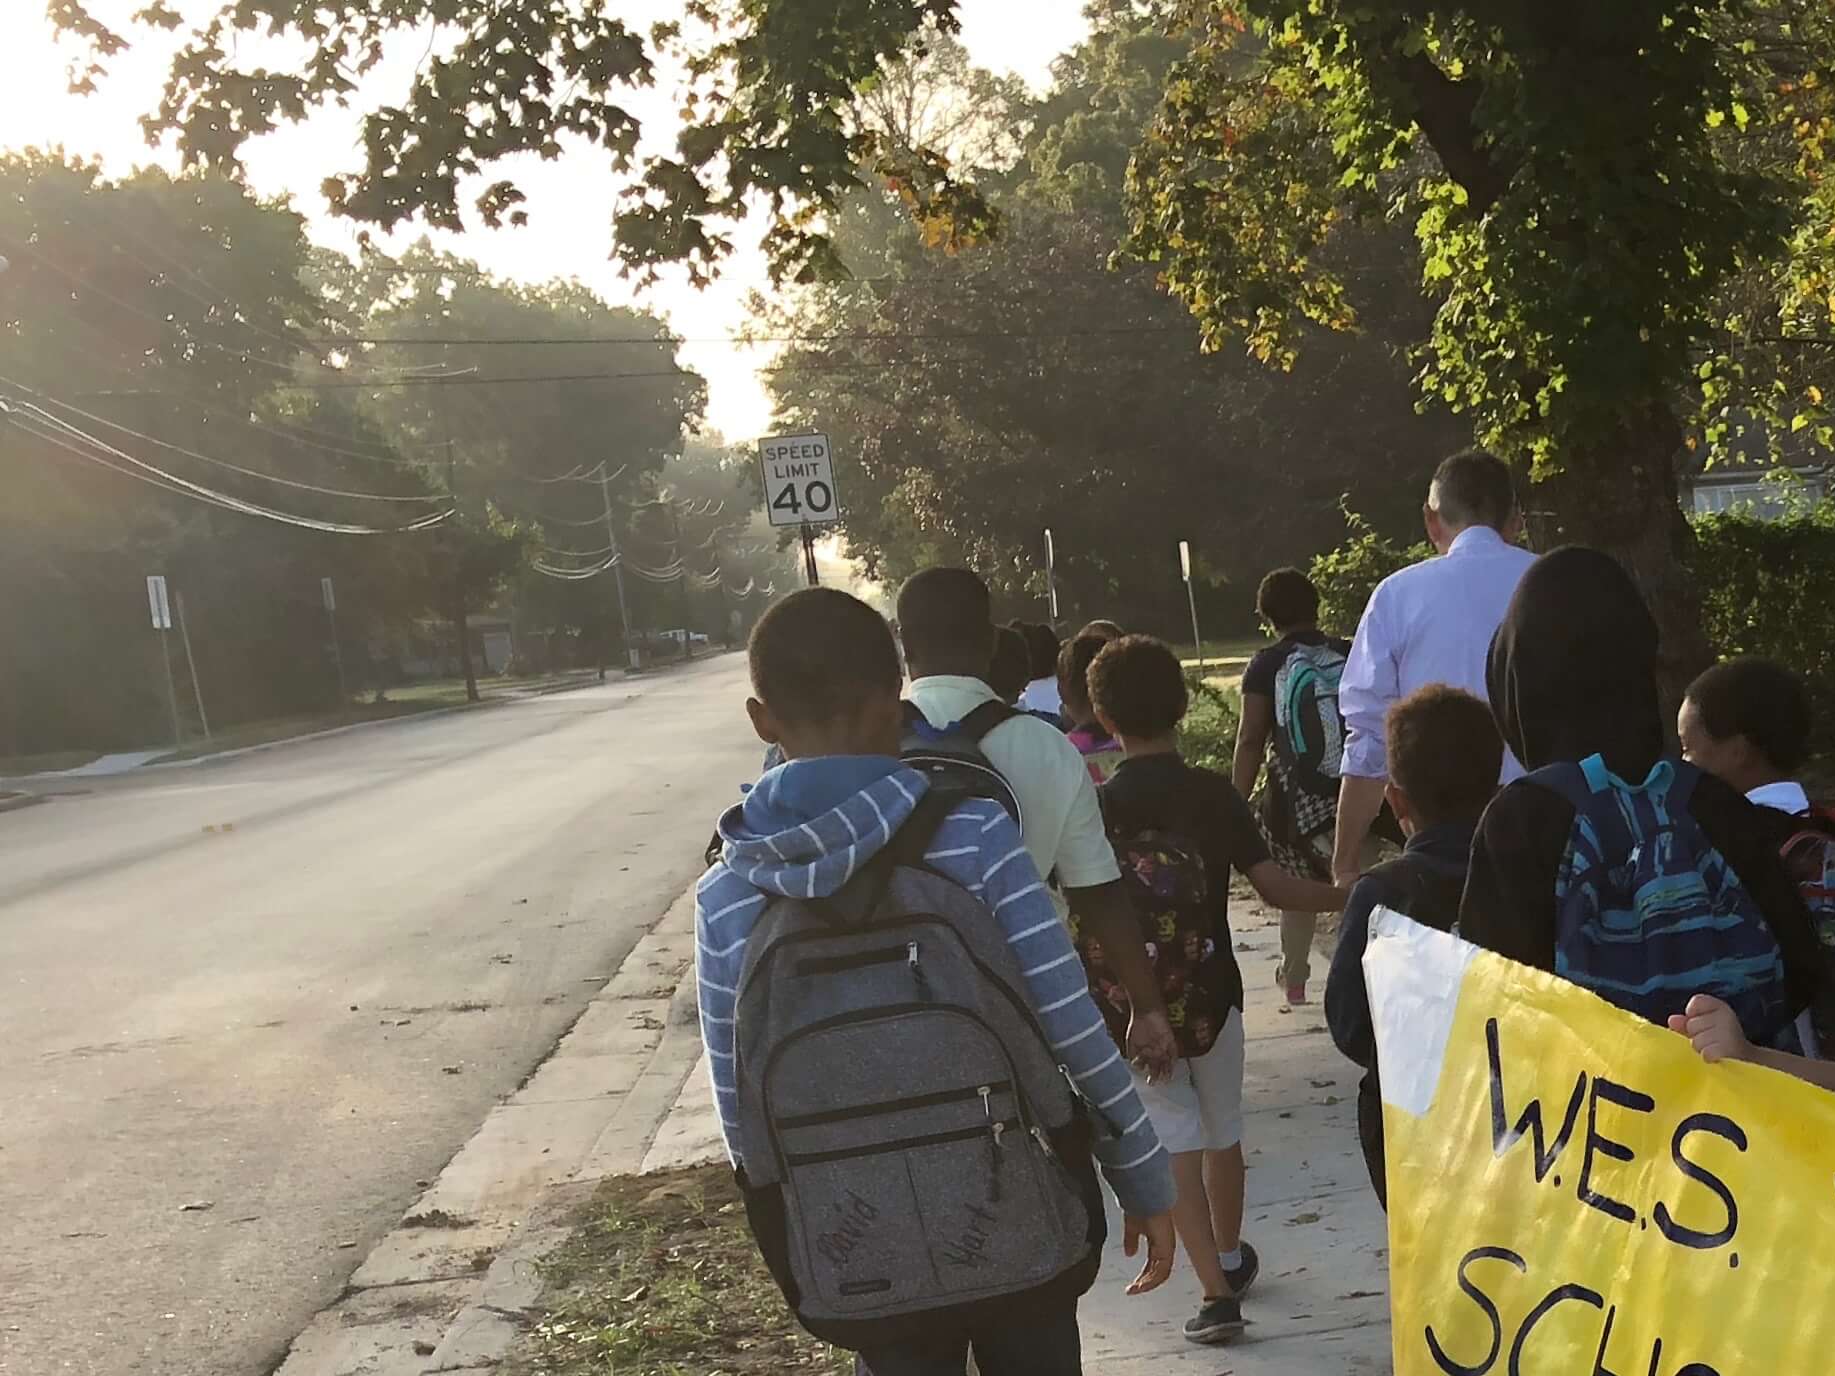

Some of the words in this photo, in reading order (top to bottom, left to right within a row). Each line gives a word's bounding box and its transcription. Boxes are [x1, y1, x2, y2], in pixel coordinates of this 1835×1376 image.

[766, 444, 824, 461] SPEED
[774, 463, 820, 479] LIMIT
[773, 481, 832, 514] 40
